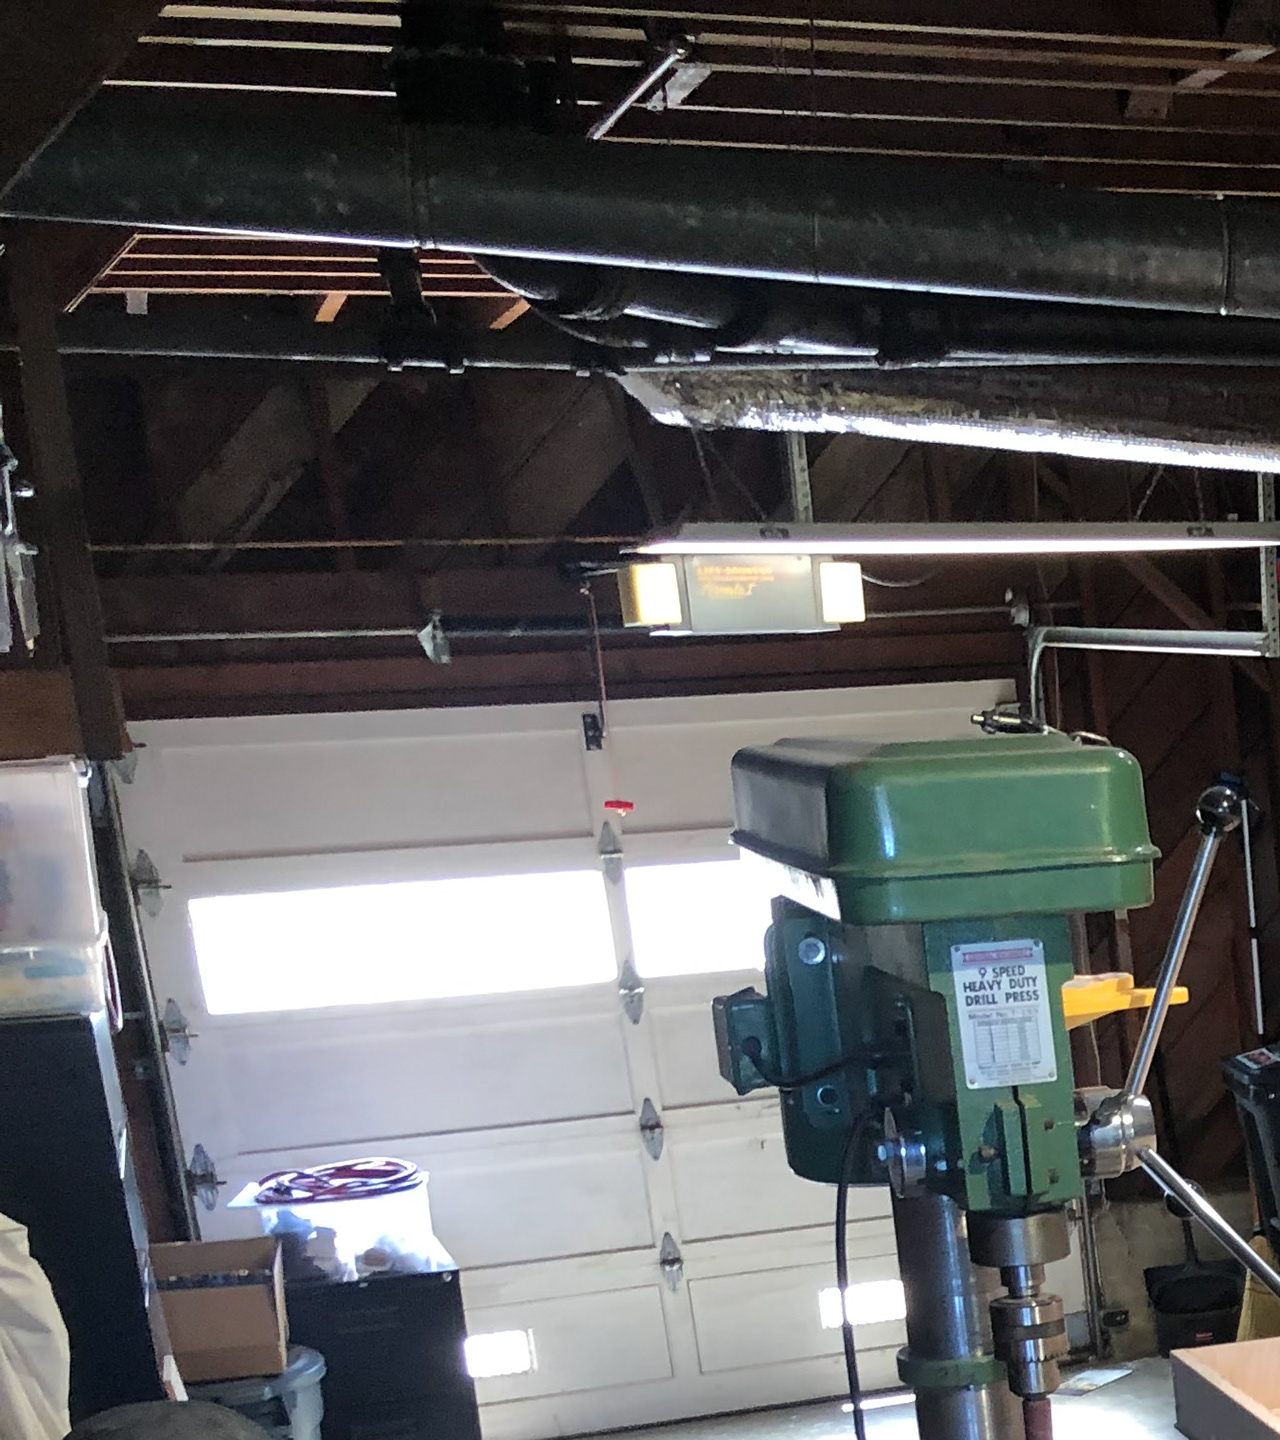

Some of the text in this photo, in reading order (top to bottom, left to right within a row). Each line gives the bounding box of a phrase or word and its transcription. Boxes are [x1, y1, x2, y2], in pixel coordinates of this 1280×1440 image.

[978, 965, 1026, 979] 9 SPEED
[963, 976, 1038, 993] HEAVY DUTY
[965, 991, 1040, 1007] DRILL PRESS
